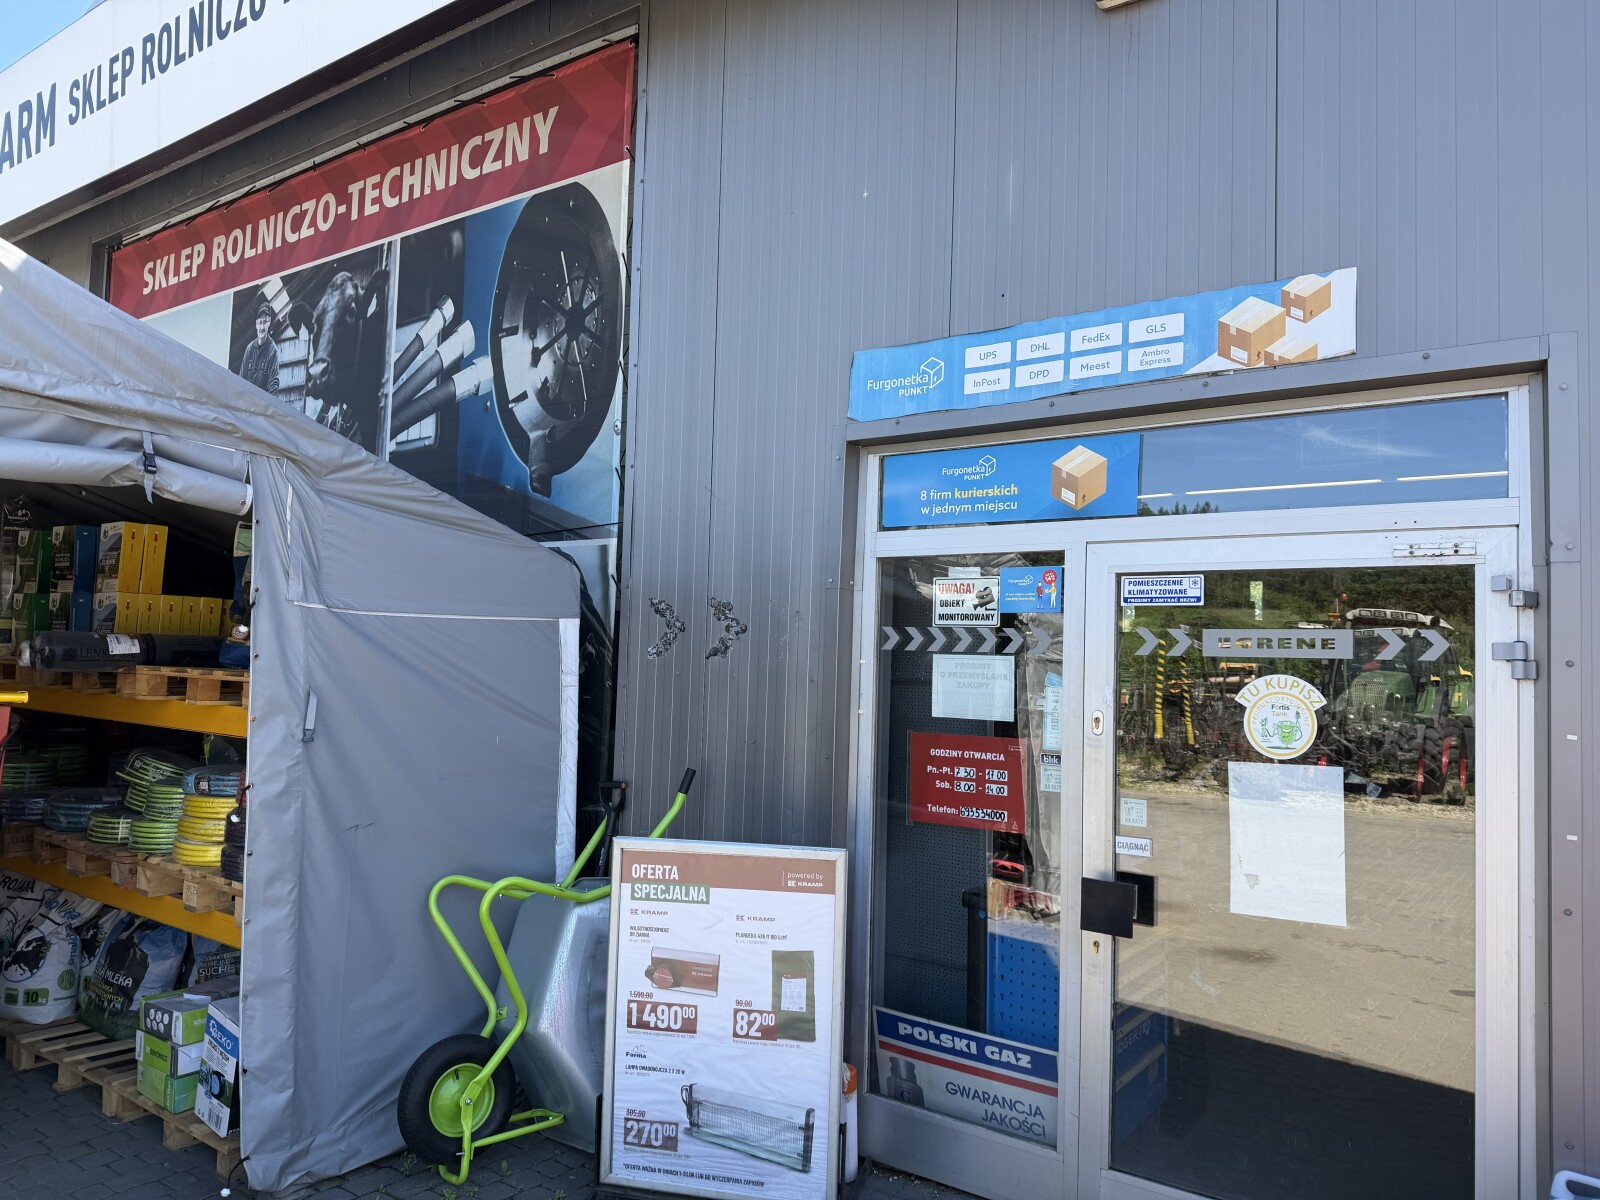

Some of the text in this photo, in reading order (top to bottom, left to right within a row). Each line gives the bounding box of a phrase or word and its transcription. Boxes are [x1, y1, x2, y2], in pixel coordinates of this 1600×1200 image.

[68, 46, 135, 126] SKLEP
[143, 105, 560, 295] SKLEP ROLNICZO-TECHNICZNY
[1146, 323, 1167, 334] GLS
[1081, 332, 1111, 344] FedEx
[1030, 342, 1050, 352] DHL
[1141, 348, 1169, 358] Ambro
[979, 351, 997, 361] UPS
[1140, 356, 1171, 367] Express
[1080, 360, 1111, 372] Meest
[1029, 369, 1050, 379] DPD
[867, 372, 929, 391] Furgonetka
[973, 376, 1001, 387] InPost
[899, 386, 928, 397] PUNKT
[942, 464, 985, 477] Furgonetka
[920, 484, 1019, 501] 8 firm kurierskich
[920, 500, 1018, 516] w jednym miejscu
[938, 583, 975, 595] UWAGA!
[939, 599, 965, 607] OBIEKT
[938, 613, 995, 621] MONITOROWANY
[955, 662, 991, 670] PROSIMY
[947, 671, 1008, 681] PRZEMYŚLANE
[956, 682, 990, 690] ZAKUPY
[1238, 677, 1324, 709] TU KUPISZ
[930, 749, 1005, 761] GODZINY OTWARCIA
[1043, 755, 1059, 764] blik
[927, 766, 953, 775] Pn.-Pt.
[935, 780, 952, 789] Sob.
[927, 804, 958, 815] Telefon:
[1117, 841, 1149, 854] CIĄGNĄĆ
[632, 863, 678, 880] OFERTA
[787, 872, 813, 880] powered
[634, 884, 707, 902] SPECJALNA
[199, 964, 235, 977] SUCHE
[105, 969, 133, 988] MLEKA
[23, 990, 39, 1002] 10
[898, 1022, 1032, 1069] POLSKI GAZ
[945, 1081, 1045, 1120] GWARANCJA
[982, 1109, 1046, 1138] JAKOŚCI
